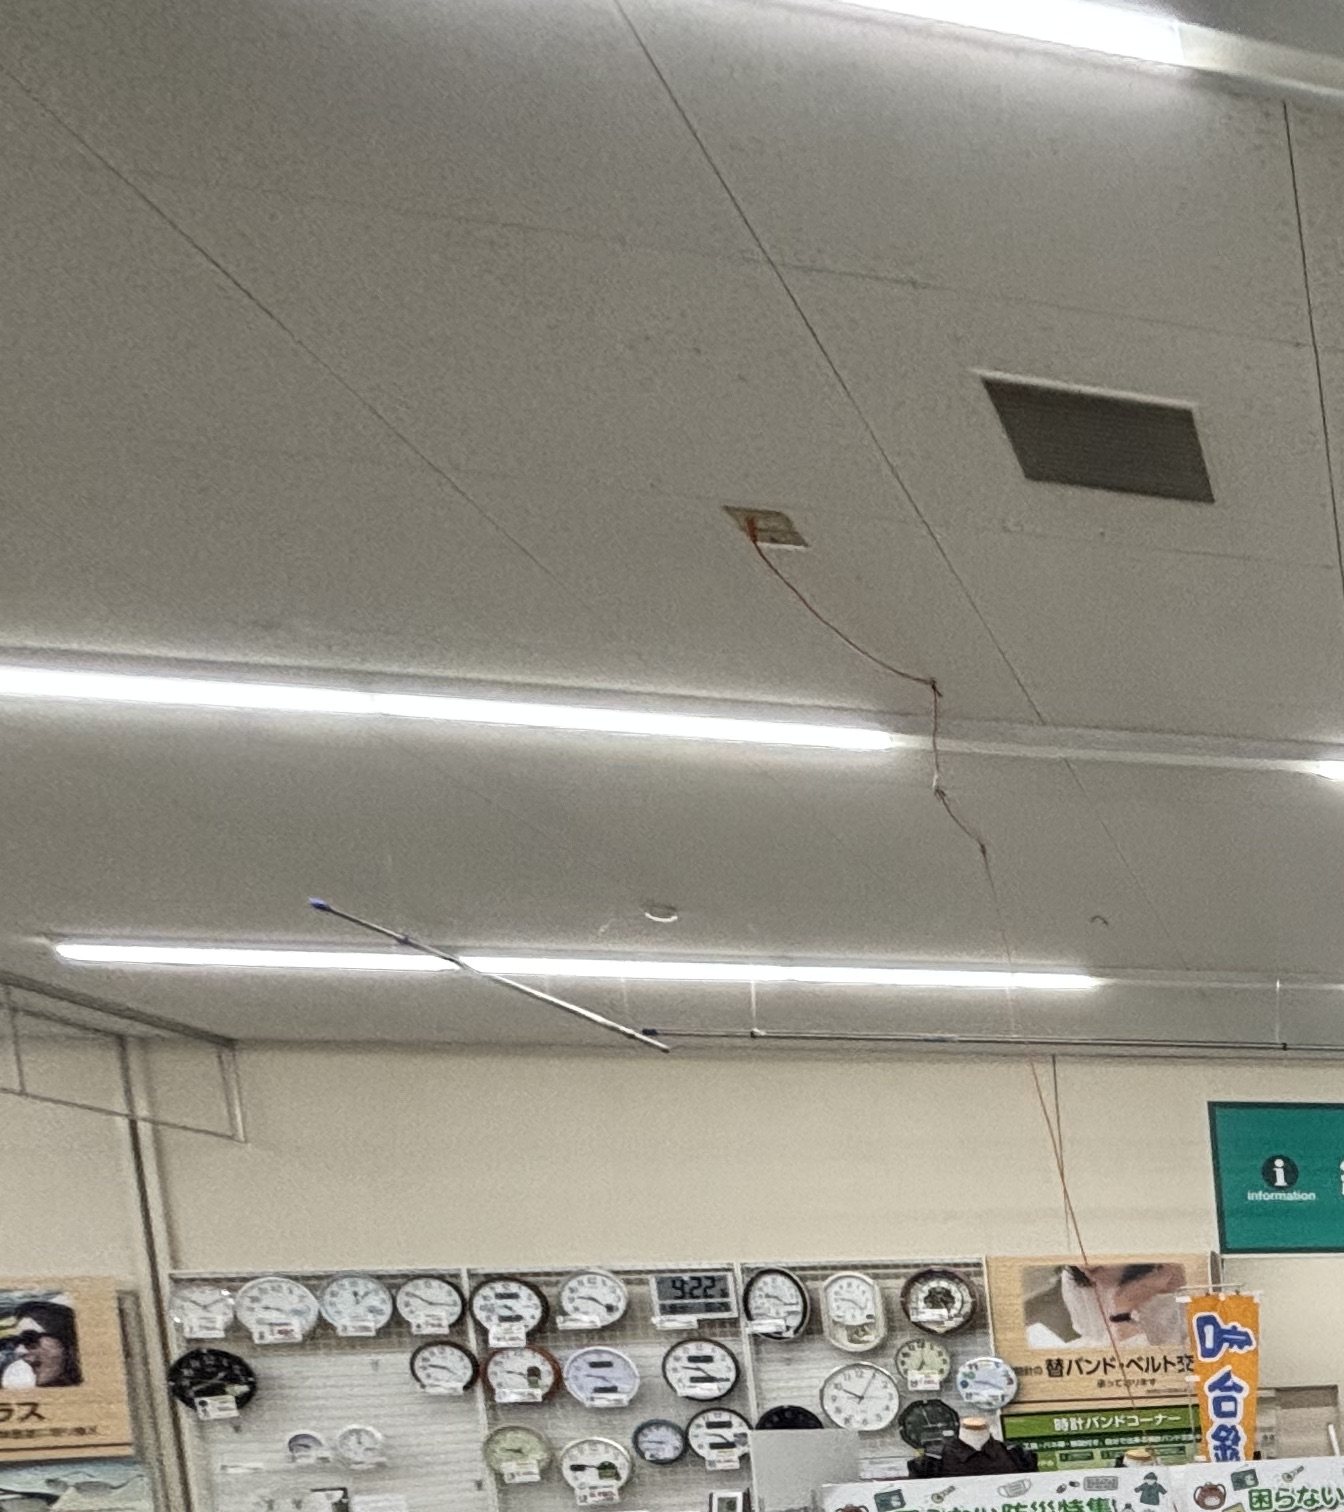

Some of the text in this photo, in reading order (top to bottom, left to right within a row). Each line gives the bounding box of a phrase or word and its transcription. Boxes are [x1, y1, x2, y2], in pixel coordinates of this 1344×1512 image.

[1247, 1190, 1316, 1202] information
[1054, 1414, 1182, 1432] 時計バンドコーナー
